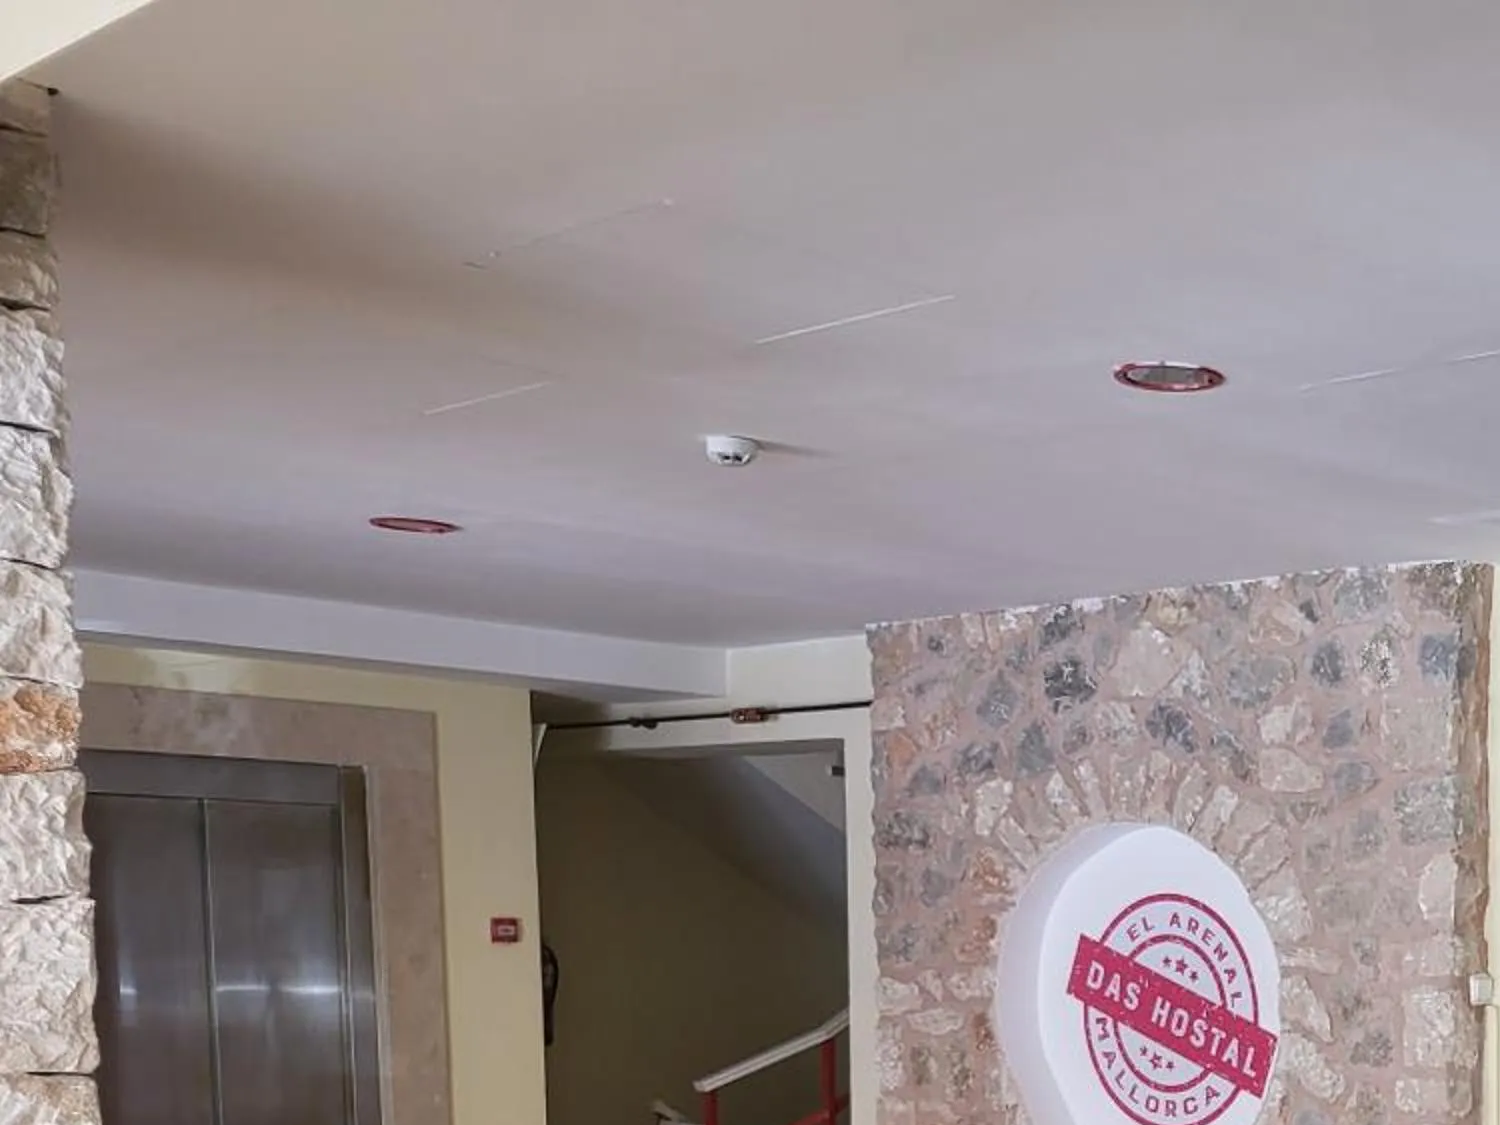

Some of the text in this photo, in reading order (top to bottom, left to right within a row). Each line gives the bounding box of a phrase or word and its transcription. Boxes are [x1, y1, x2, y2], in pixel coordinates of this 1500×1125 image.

[1126, 911, 1243, 1008] EL ARENAL
[1086, 960, 1258, 1077] DAS HOSTAL
[1095, 1016, 1221, 1118] MALLORCA
